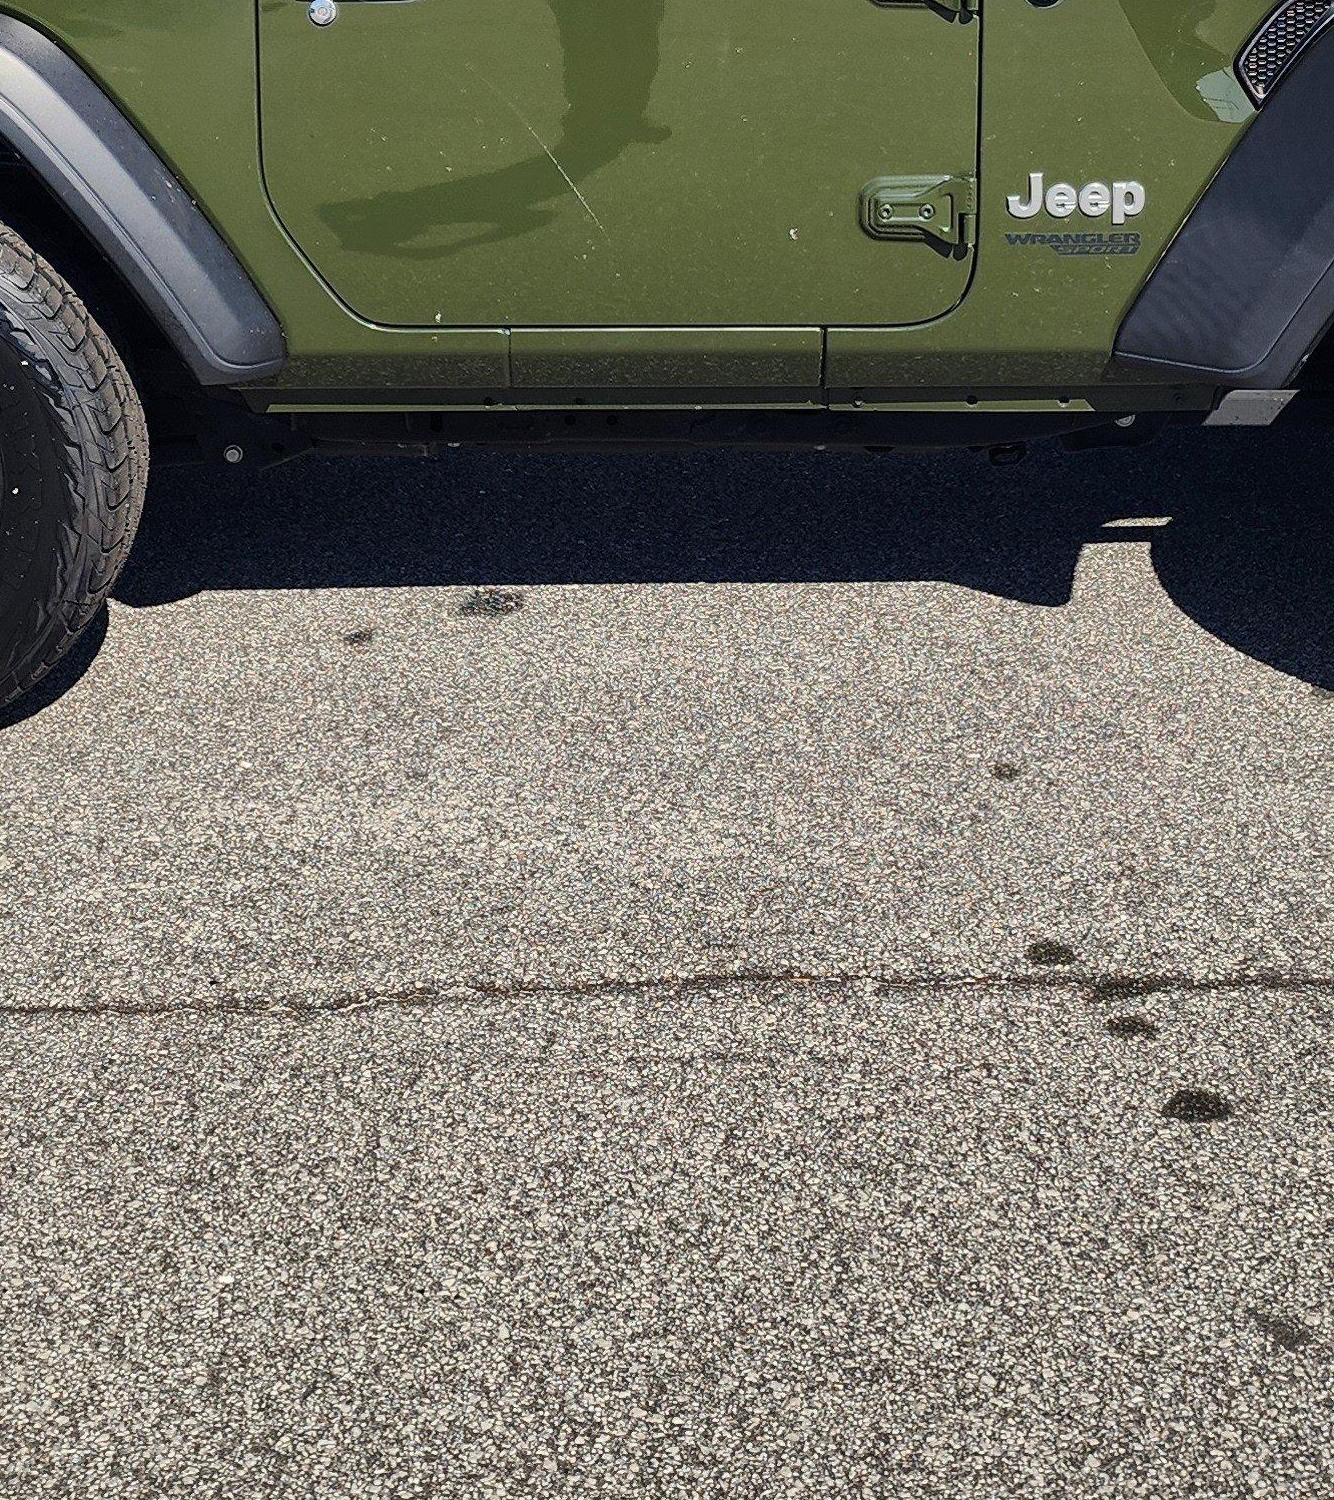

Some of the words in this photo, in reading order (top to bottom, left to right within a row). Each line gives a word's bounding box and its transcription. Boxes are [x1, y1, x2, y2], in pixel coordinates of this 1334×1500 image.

[1006, 172, 1146, 225] Jeep
[1004, 232, 1141, 245] WRANGLER
[1054, 244, 1138, 255] SPORT
